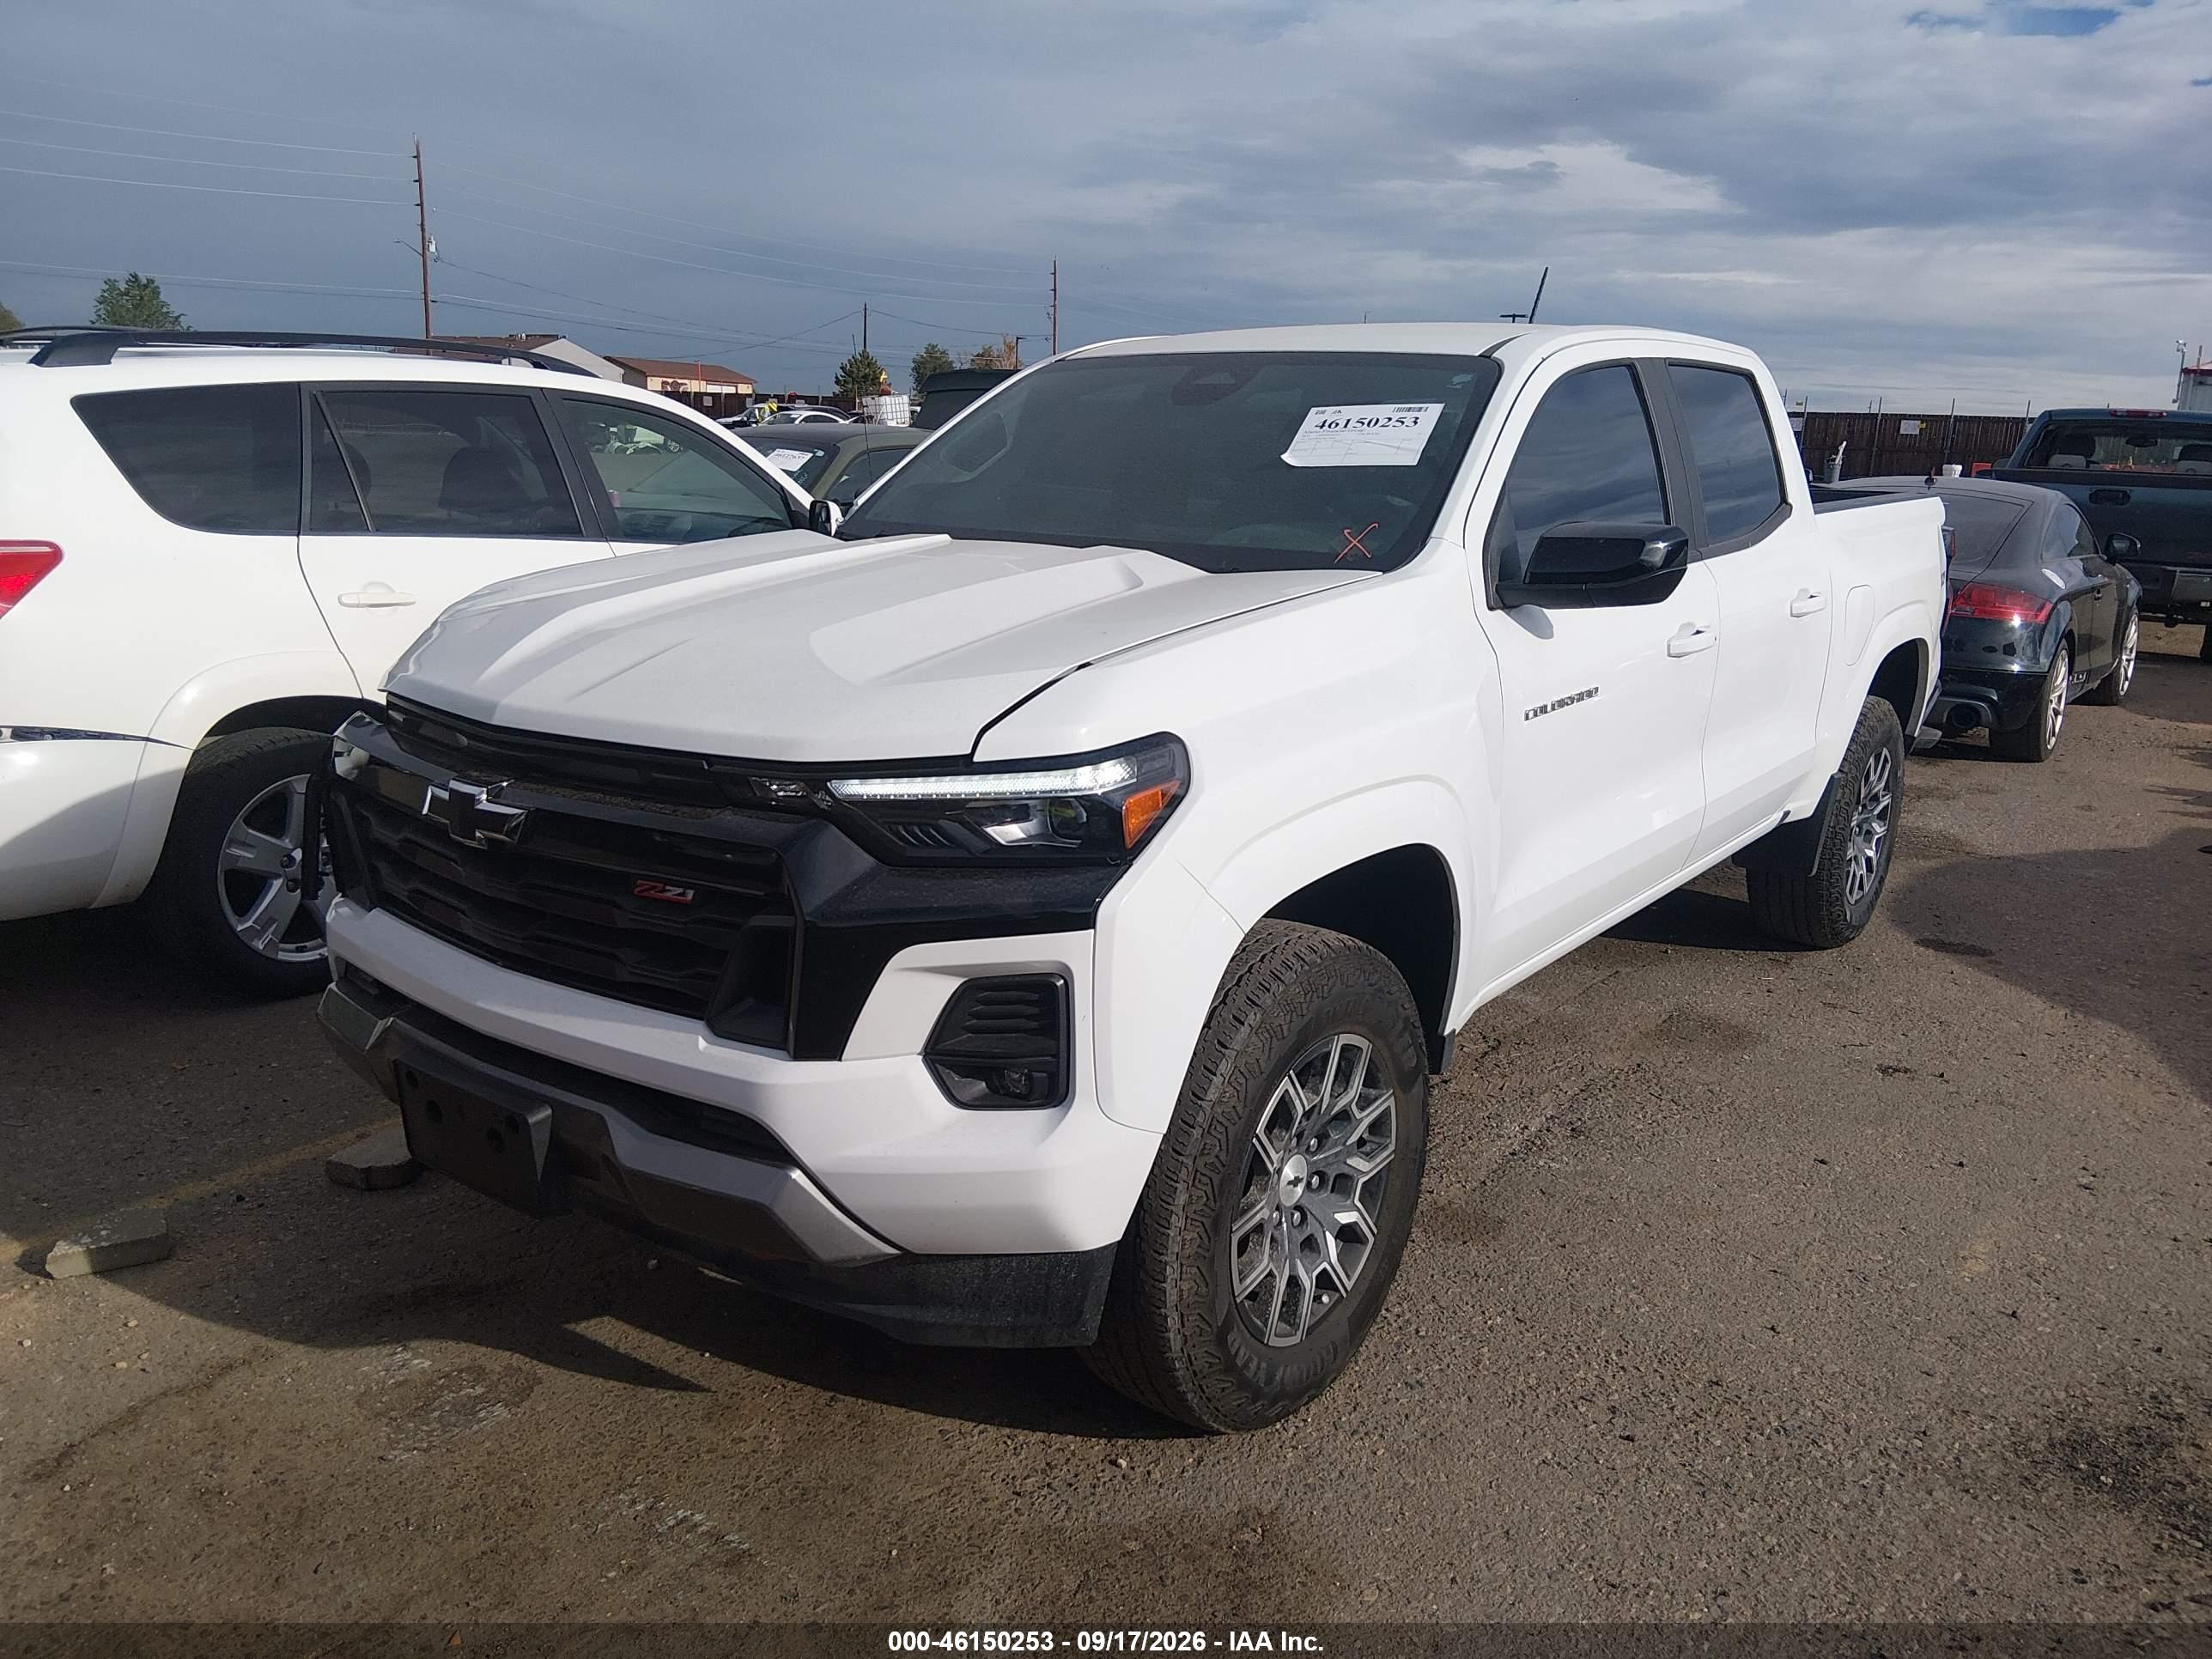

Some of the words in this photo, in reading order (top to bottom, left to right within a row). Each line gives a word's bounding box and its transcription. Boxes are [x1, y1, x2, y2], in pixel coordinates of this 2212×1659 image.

[1314, 416, 1420, 430] 46150253
[1523, 686, 1600, 722] COLORADO
[632, 879, 696, 904] Z71
